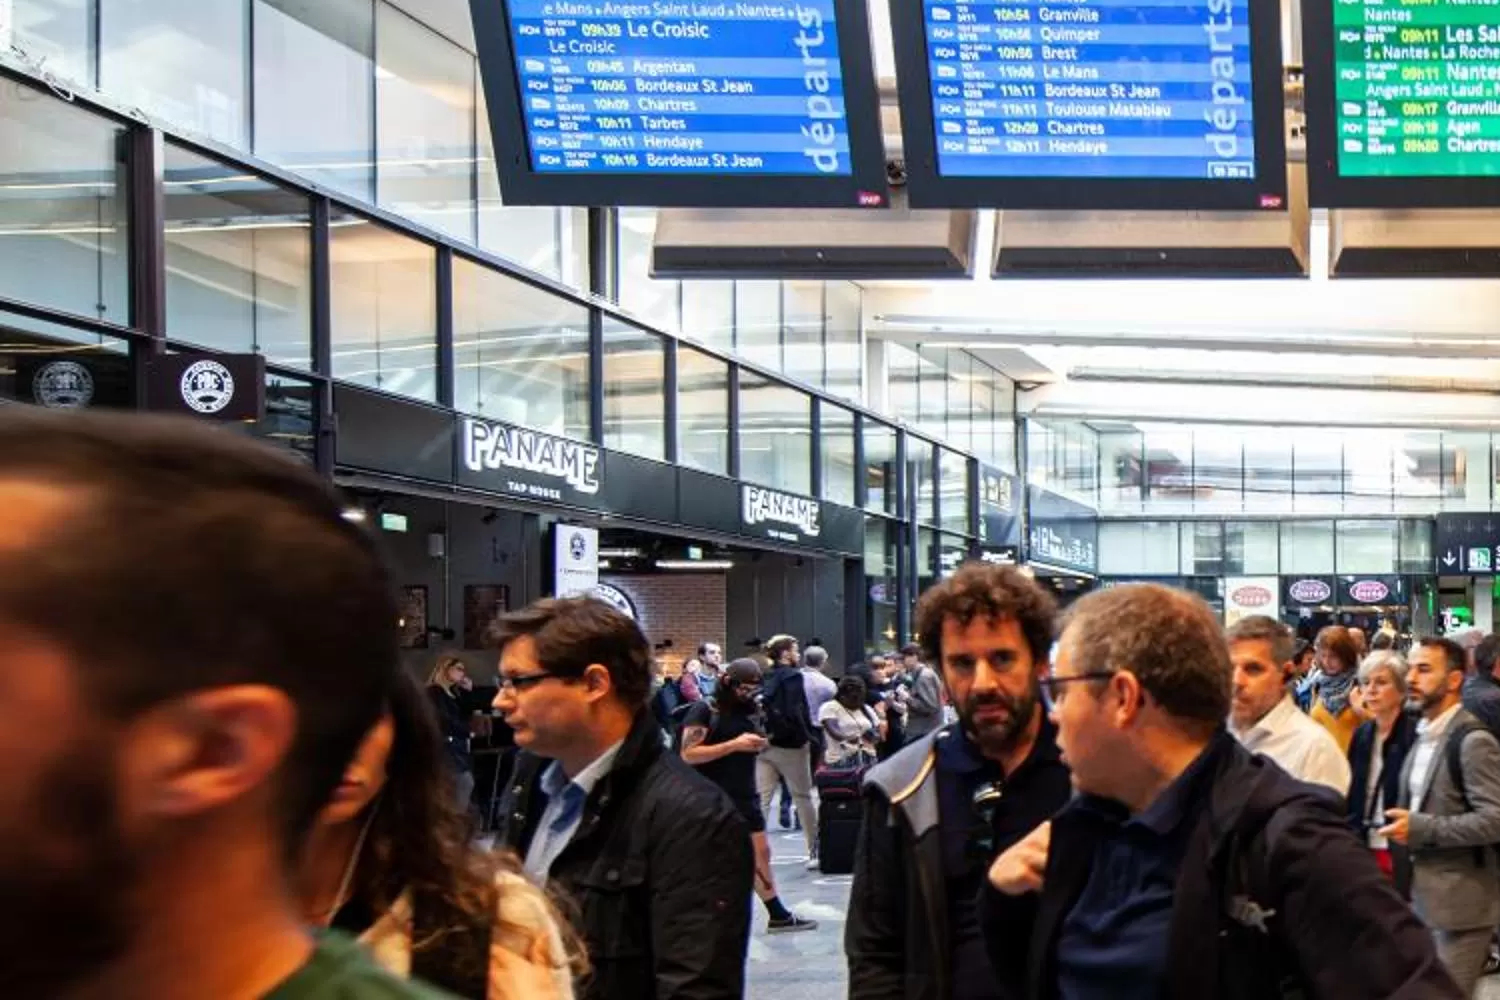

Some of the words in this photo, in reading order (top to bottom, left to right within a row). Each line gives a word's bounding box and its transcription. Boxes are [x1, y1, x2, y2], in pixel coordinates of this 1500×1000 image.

[556, 2, 593, 15] Mans
[604, 2, 650, 17] Angers
[653, 2, 689, 16] Saint
[692, 2, 725, 17] Laud
[736, 3, 785, 17] Nantes
[1039, 7, 1099, 22] Granville
[1364, 8, 1412, 21] Nantes
[628, 21, 648, 37] Le
[652, 21, 710, 38] Croisic
[1040, 26, 1100, 43] Quimper
[1446, 25, 1474, 43] Les
[550, 40, 566, 53] Le
[569, 39, 616, 53] Croisic
[1042, 46, 1077, 60] Brest
[1383, 46, 1430, 59] Nantes
[1441, 46, 1456, 59] La
[1459, 46, 1500, 59] Roche
[633, 59, 695, 76] Argentan
[1043, 65, 1060, 79] Le
[1063, 65, 1099, 79] Mans
[635, 78, 699, 92] Bordeaux
[702, 79, 718, 93] St
[721, 79, 753, 93] Jean
[794, 6, 843, 172] départs
[1045, 84, 1107, 98] Bordeaux
[1111, 85, 1126, 98] St
[1128, 84, 1160, 99] Jean
[1366, 83, 1412, 100] Angers
[1414, 83, 1449, 97] Saint
[1451, 83, 1484, 97] Laud
[638, 97, 697, 111] Chartres
[1046, 102, 1106, 116] Toulouse
[640, 116, 686, 130] Tarbes
[1047, 121, 1104, 135] Chartres
[643, 135, 704, 151] Hendaye
[1049, 140, 1108, 155] Hendaye
[646, 154, 709, 167] Bordeaux
[712, 154, 728, 167] St
[731, 154, 763, 168] Jean
[464, 419, 600, 495] PANAME
[507, 481, 527, 493] TAP
[743, 485, 820, 538] PANAME
